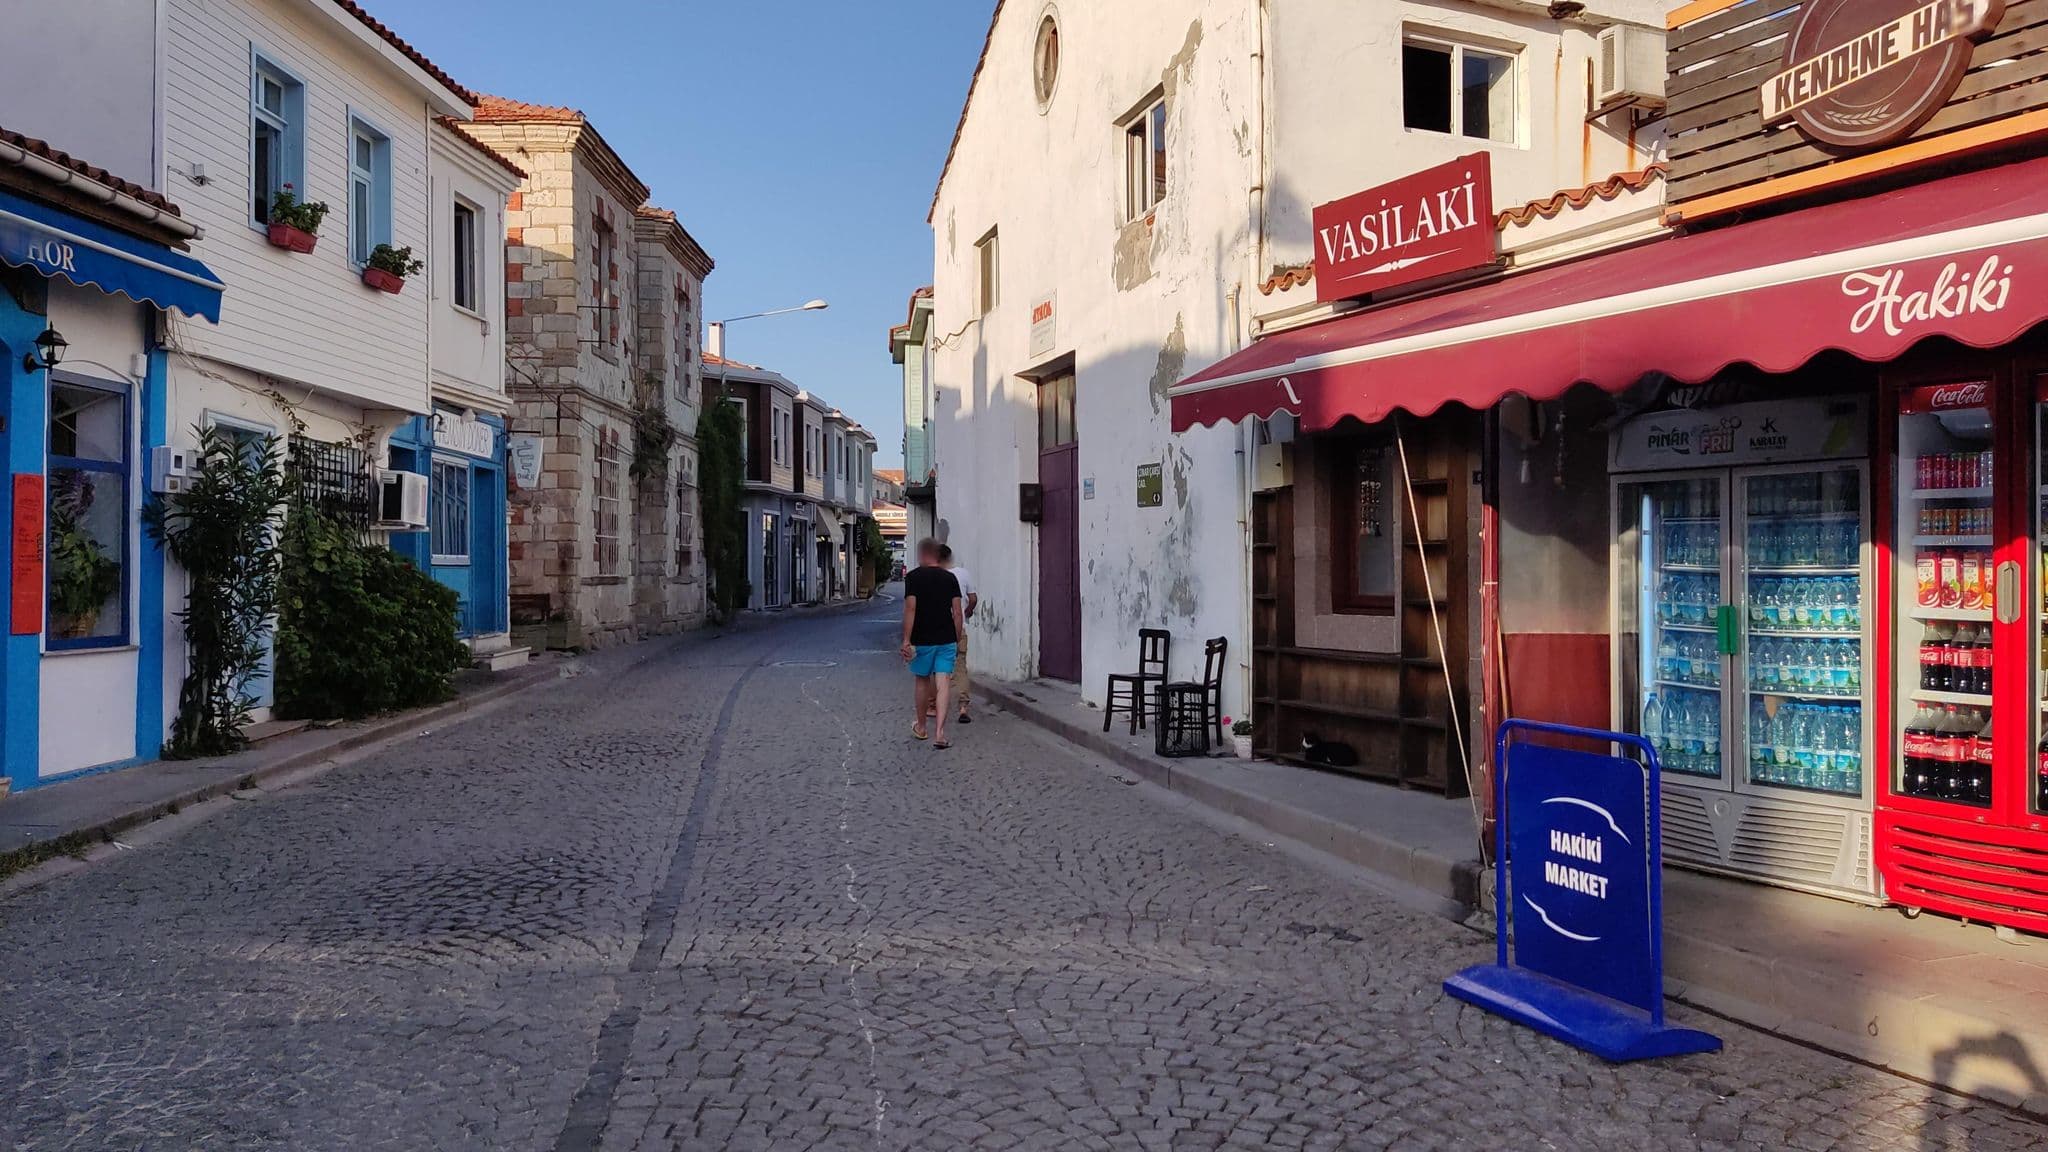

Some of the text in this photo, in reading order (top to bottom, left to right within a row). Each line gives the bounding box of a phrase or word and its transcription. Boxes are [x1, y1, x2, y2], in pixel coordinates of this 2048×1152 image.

[1319, 170, 1478, 266] VASİLAKİ
[1841, 254, 2014, 337] Hakiki
[1931, 384, 1987, 408] Coca-Cola
[1549, 829, 1602, 864] HAKİKİ
[1545, 861, 1609, 899] MARKET
